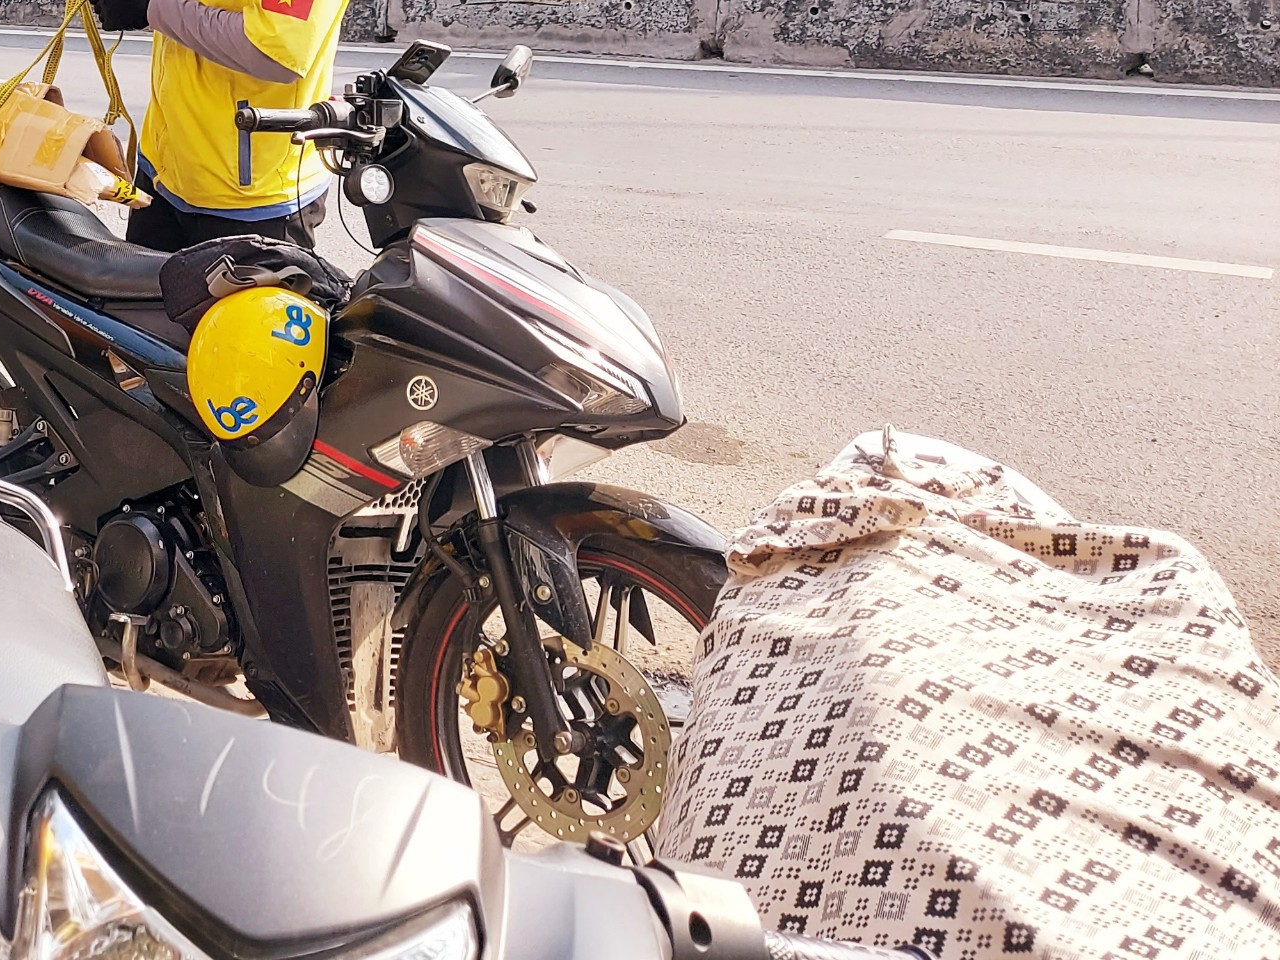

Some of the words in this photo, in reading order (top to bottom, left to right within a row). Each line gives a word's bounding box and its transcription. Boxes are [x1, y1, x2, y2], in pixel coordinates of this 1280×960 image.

[27, 287, 53, 306] VVA
[271, 304, 313, 347] be
[205, 395, 259, 434] be
